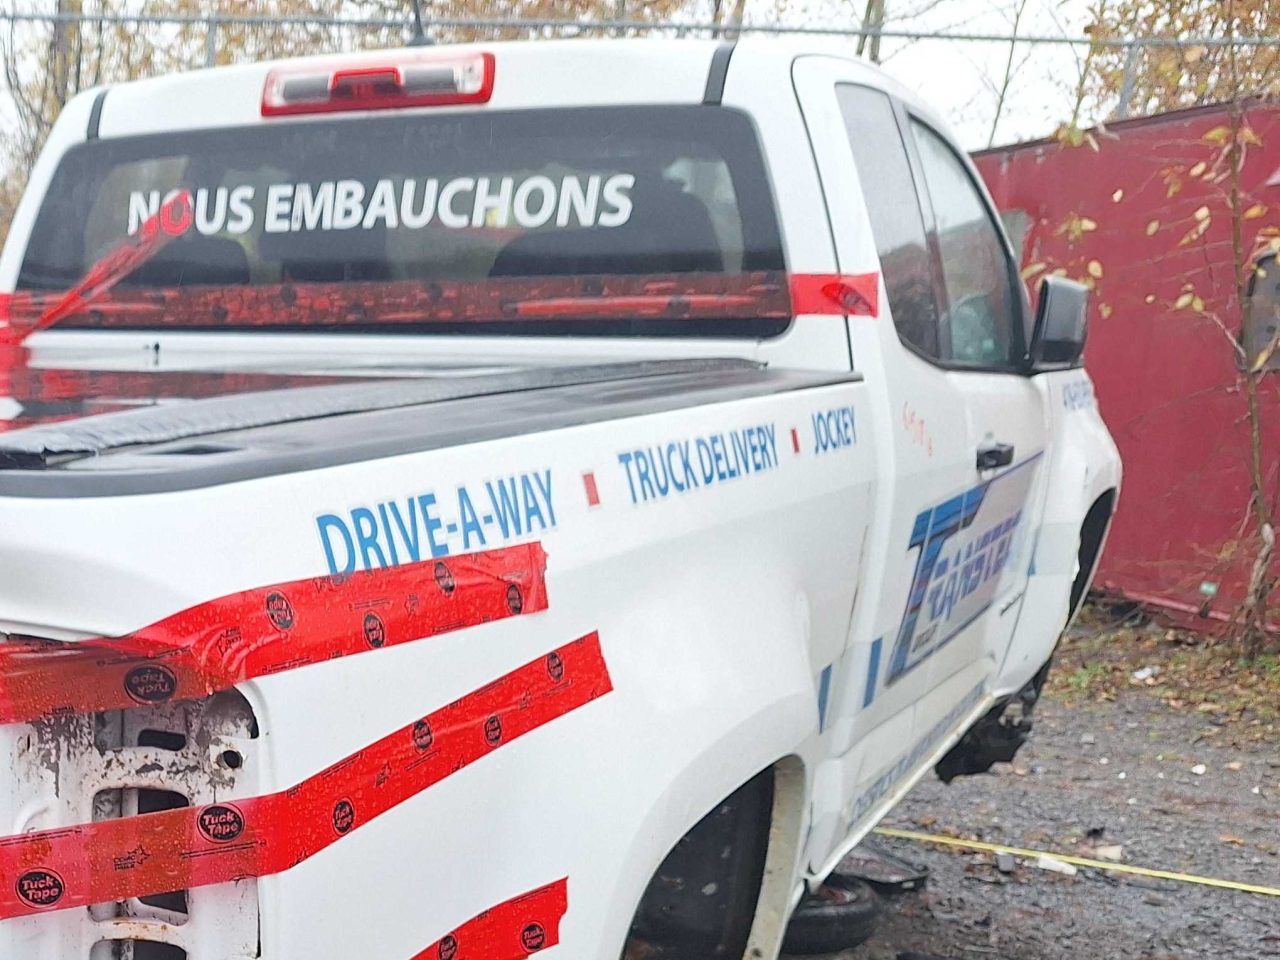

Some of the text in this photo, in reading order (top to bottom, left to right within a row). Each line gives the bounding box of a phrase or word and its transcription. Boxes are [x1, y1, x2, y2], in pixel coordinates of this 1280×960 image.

[127, 173, 636, 236] NOUS EMBAUCHONS
[316, 468, 558, 580] DRIVE-A-WAY
[617, 437, 699, 504] TRUCK
[696, 423, 779, 485] DELIVERY
[811, 405, 857, 455] JOCKEY
[131, 672, 164, 684] Tape
[138, 683, 169, 696] Tuck
[203, 811, 235, 825] Tuck
[207, 822, 239, 836] Tape
[22, 876, 54, 890] Tuck
[27, 887, 60, 900] Tape
[524, 926, 541, 940] Tuck
